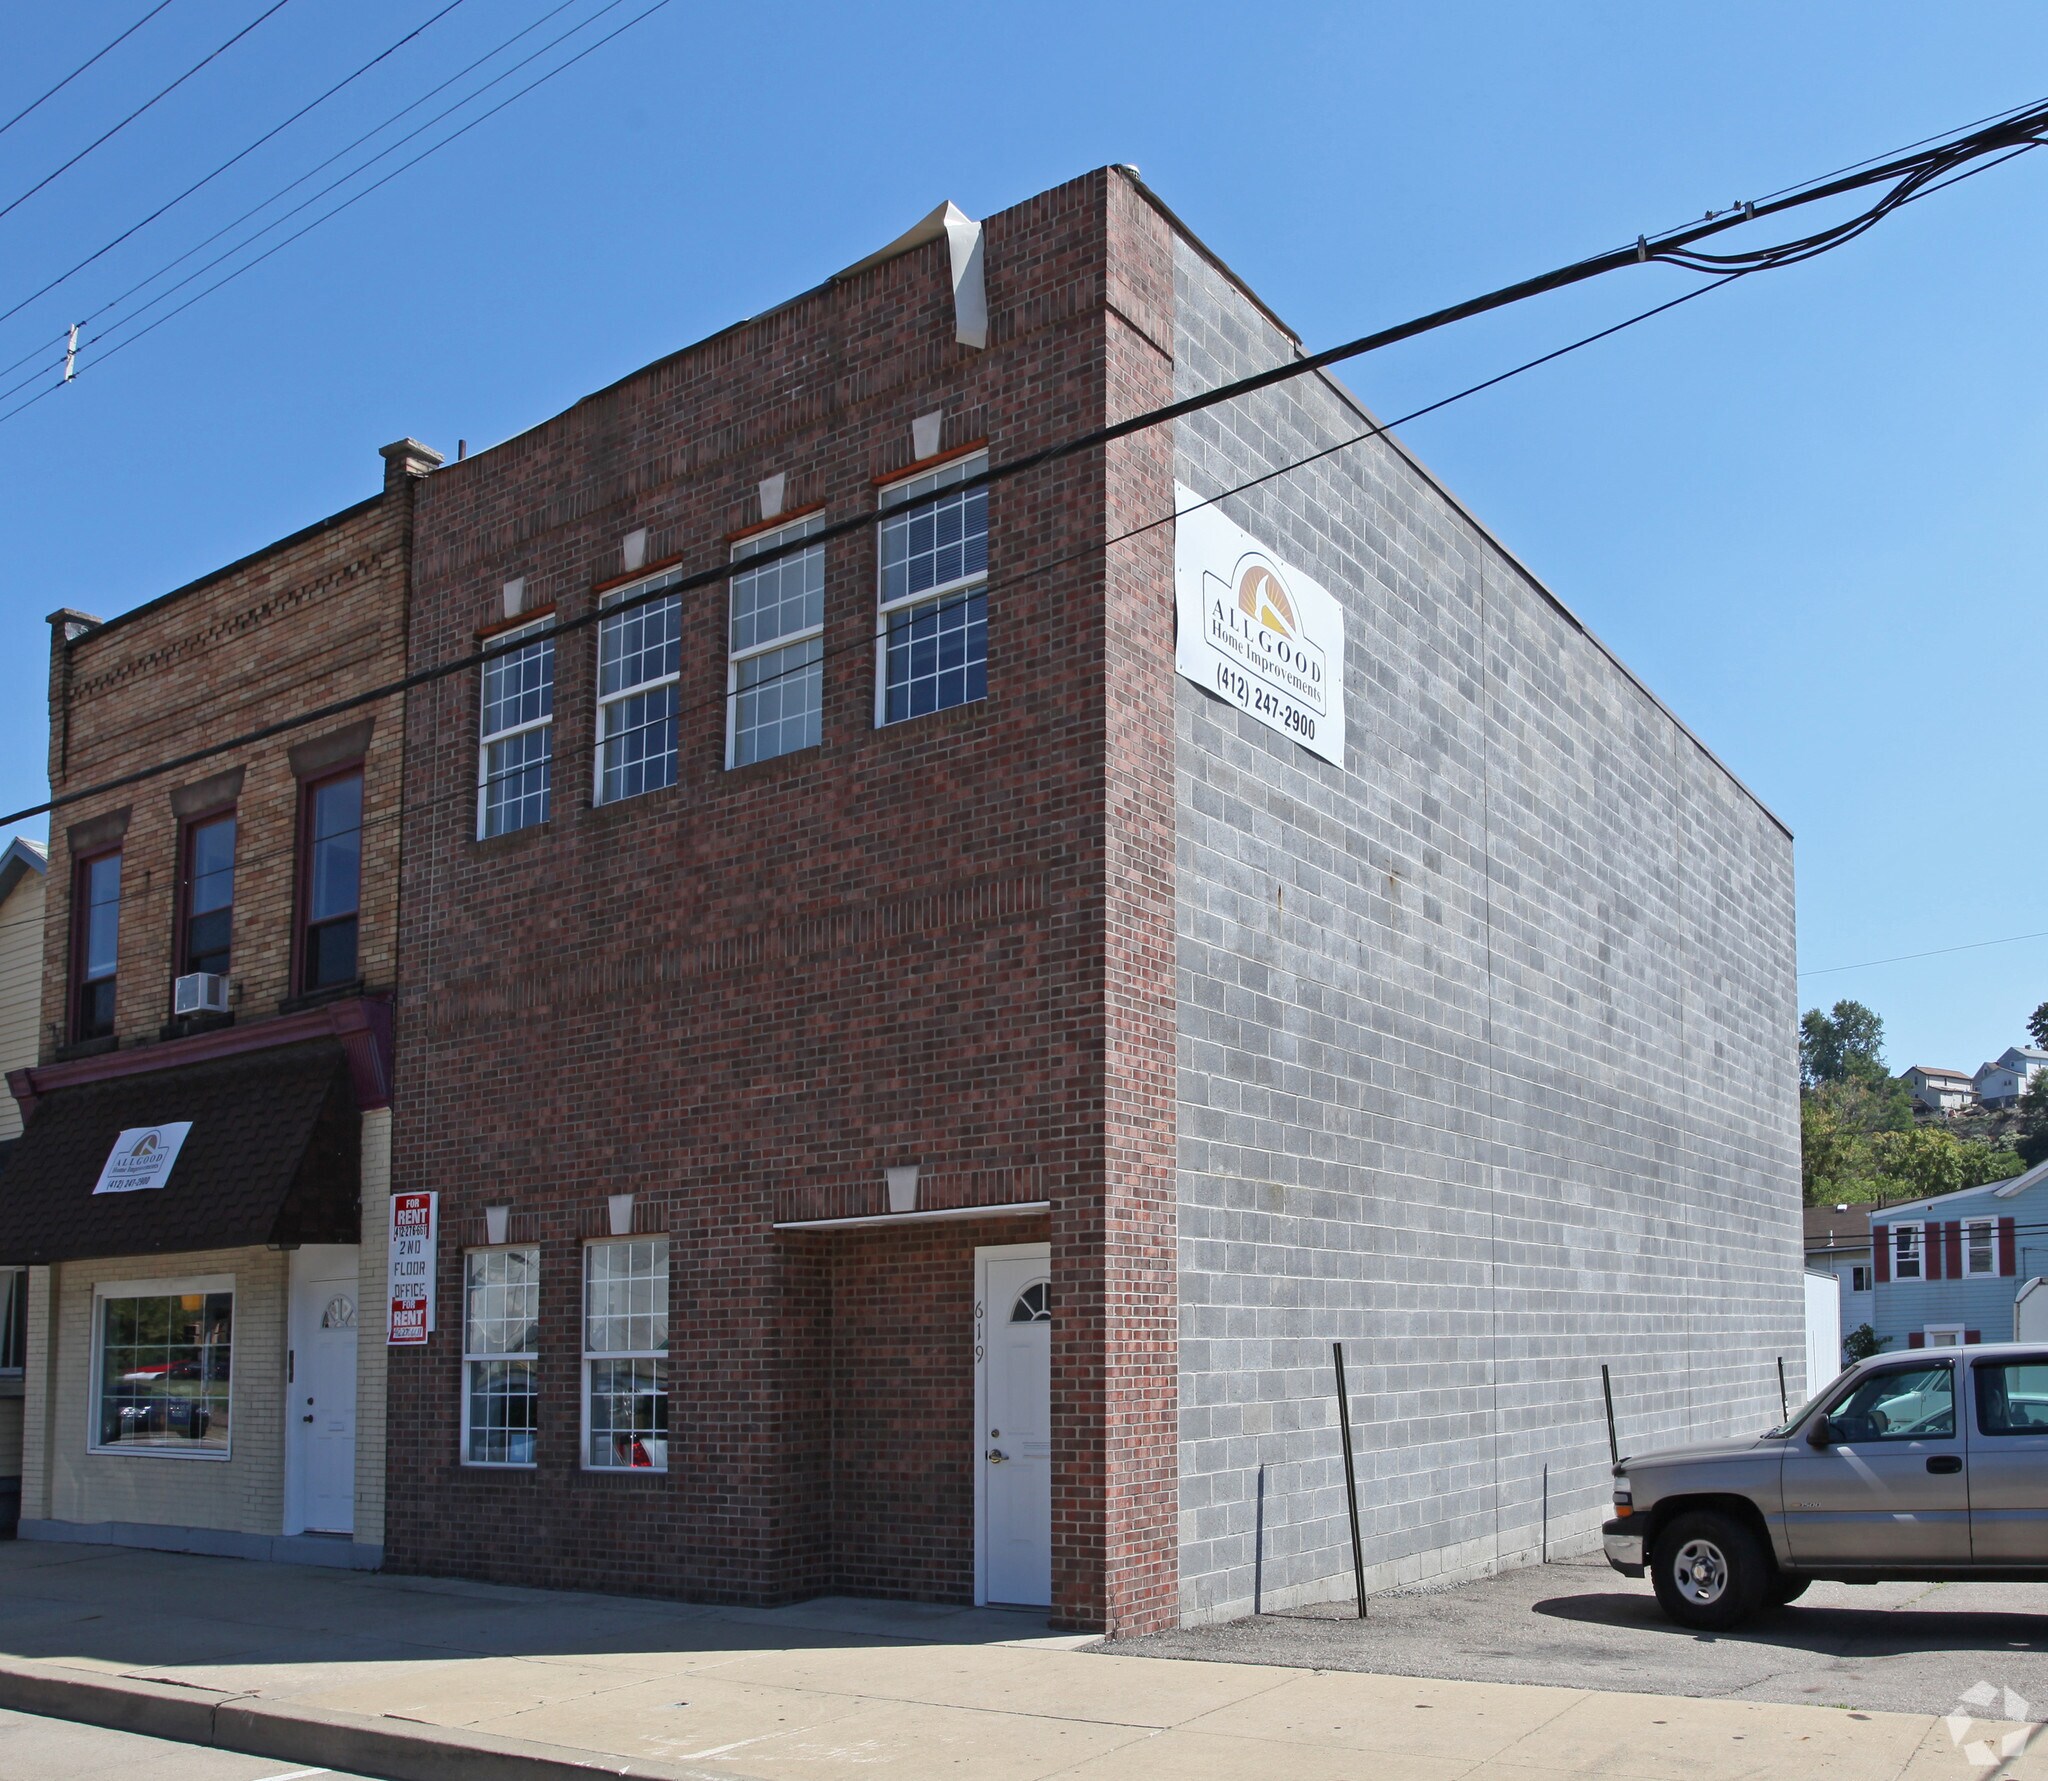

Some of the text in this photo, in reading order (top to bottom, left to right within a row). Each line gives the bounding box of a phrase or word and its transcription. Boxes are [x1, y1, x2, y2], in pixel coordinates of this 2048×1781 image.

[1212, 598, 1321, 683] ALLGOOD
[1212, 619, 1321, 702] Home Improvements
[1217, 662, 1315, 740] (412) 247-2900
[116, 1154, 163, 1166] ALLGOOD
[406, 1199, 420, 1208] FOR
[398, 1208, 427, 1225] RENT
[394, 1261, 425, 1276] FLOOR
[395, 1283, 425, 1298] OFFICE
[402, 1300, 415, 1309] FOR
[393, 1310, 423, 1326] RENT
[975, 1300, 984, 1364] 619
